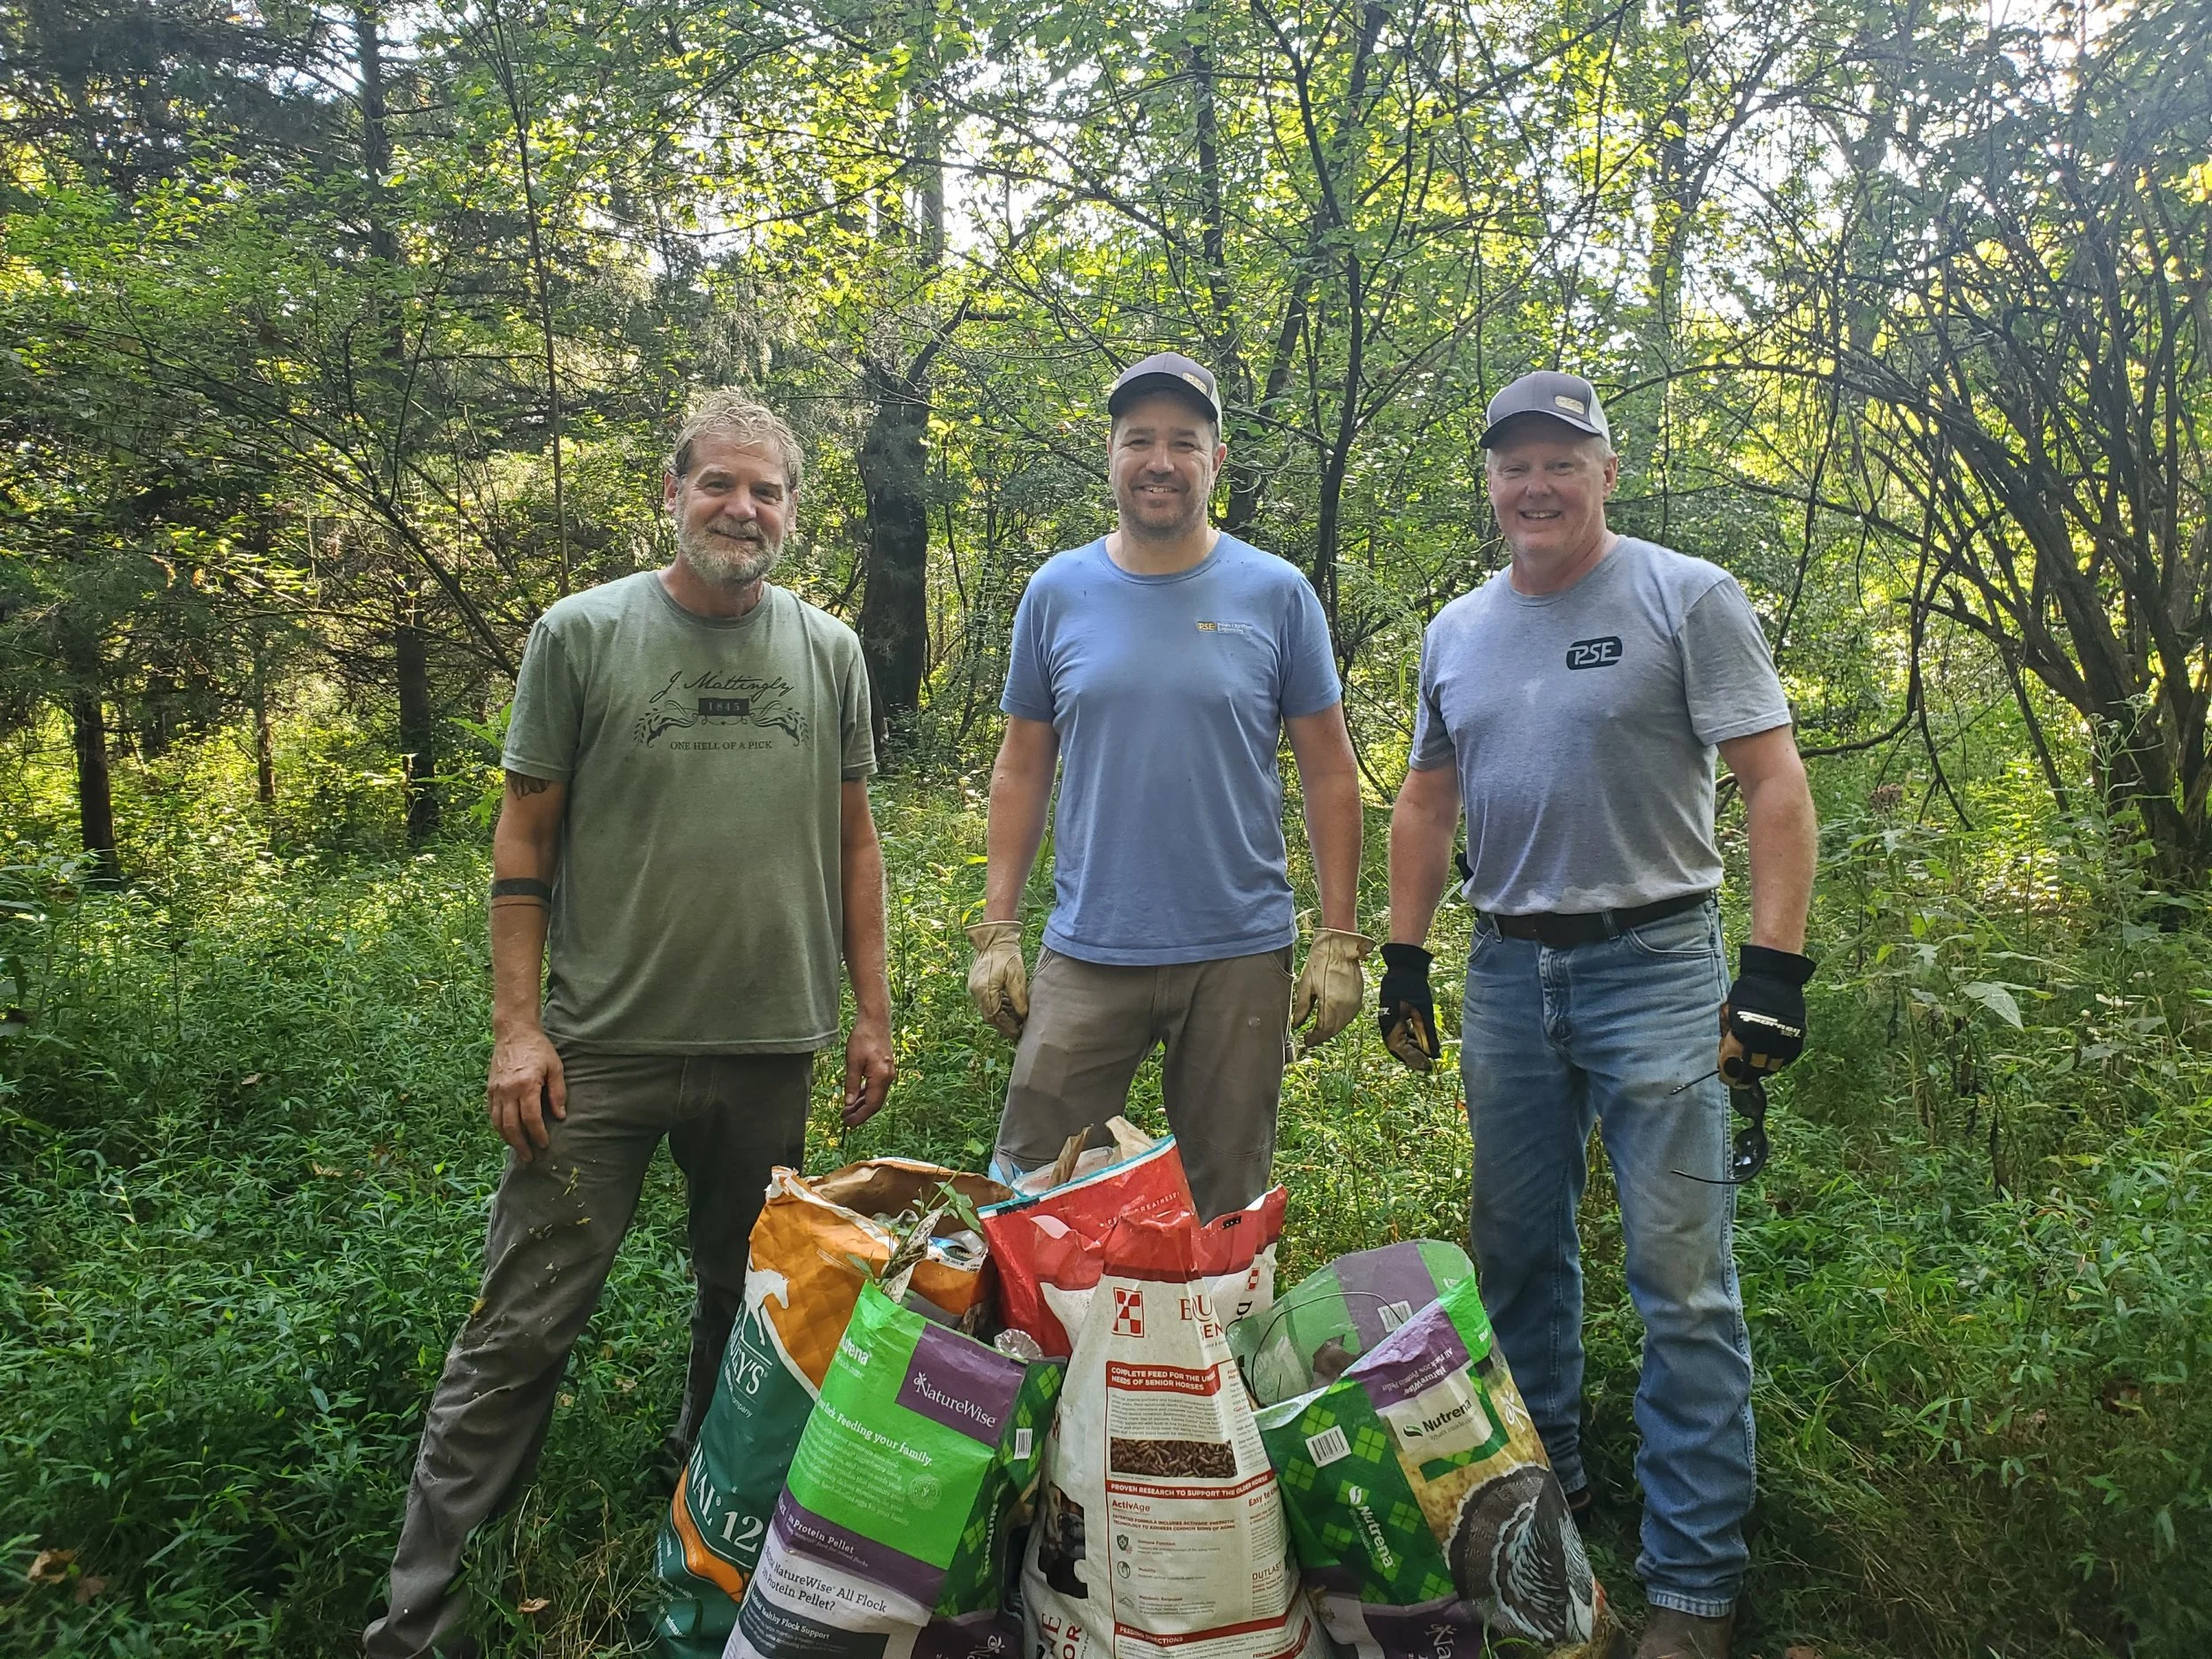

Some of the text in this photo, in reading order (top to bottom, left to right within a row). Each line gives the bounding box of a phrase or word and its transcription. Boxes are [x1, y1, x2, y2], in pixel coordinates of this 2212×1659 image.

[1569, 641, 1621, 665] PSE
[649, 670, 795, 703] J. Mattingly
[708, 702, 741, 711] 1845
[670, 741, 772, 751] ONE HELL OF A PICK
[1111, 1366, 1147, 1379] COMPLETE
[1148, 1370, 1168, 1379] FEED
[1170, 1371, 1185, 1380] FOR
[1186, 1373, 1200, 1382] THE
[1111, 1376, 1132, 1386] NEEDS
[1145, 1379, 1174, 1387] SENIOR
[1175, 1381, 1204, 1391] HORSES
[913, 1371, 996, 1427] NatureWise
[1422, 1399, 1472, 1432] Nutrena
[836, 1413, 872, 1440] Feeding
[873, 1433, 899, 1450] your
[899, 1441, 932, 1466] family.
[1110, 1483, 1138, 1493] PROVEN
[1139, 1486, 1175, 1496] RESEARCH
[1187, 1488, 1219, 1497] SUPPORT
[1222, 1487, 1235, 1496] THE
[1236, 1481, 1252, 1495] OLDER
[1252, 1475, 1268, 1488] HORSE
[1112, 1500, 1150, 1512] ActivAge
[1248, 1494, 1263, 1508] Easy
[1263, 1490, 1271, 1500] to
[719, 1510, 764, 1553] 12
[794, 1519, 826, 1542] Protein
[828, 1534, 855, 1553] Pellet
[1356, 1505, 1394, 1568] Nutrena
[1252, 1561, 1282, 1580] OUTLAST
[767, 1572, 795, 1598] Protein
[798, 1589, 836, 1611] Pellet?
[774, 1561, 833, 1594] NatureWise
[836, 1587, 854, 1601] All
[856, 1594, 887, 1613] Flock
[780, 1617, 800, 1632] Flock
[801, 1625, 830, 1640] Support
[1119, 1626, 1144, 1638] FEEDING
